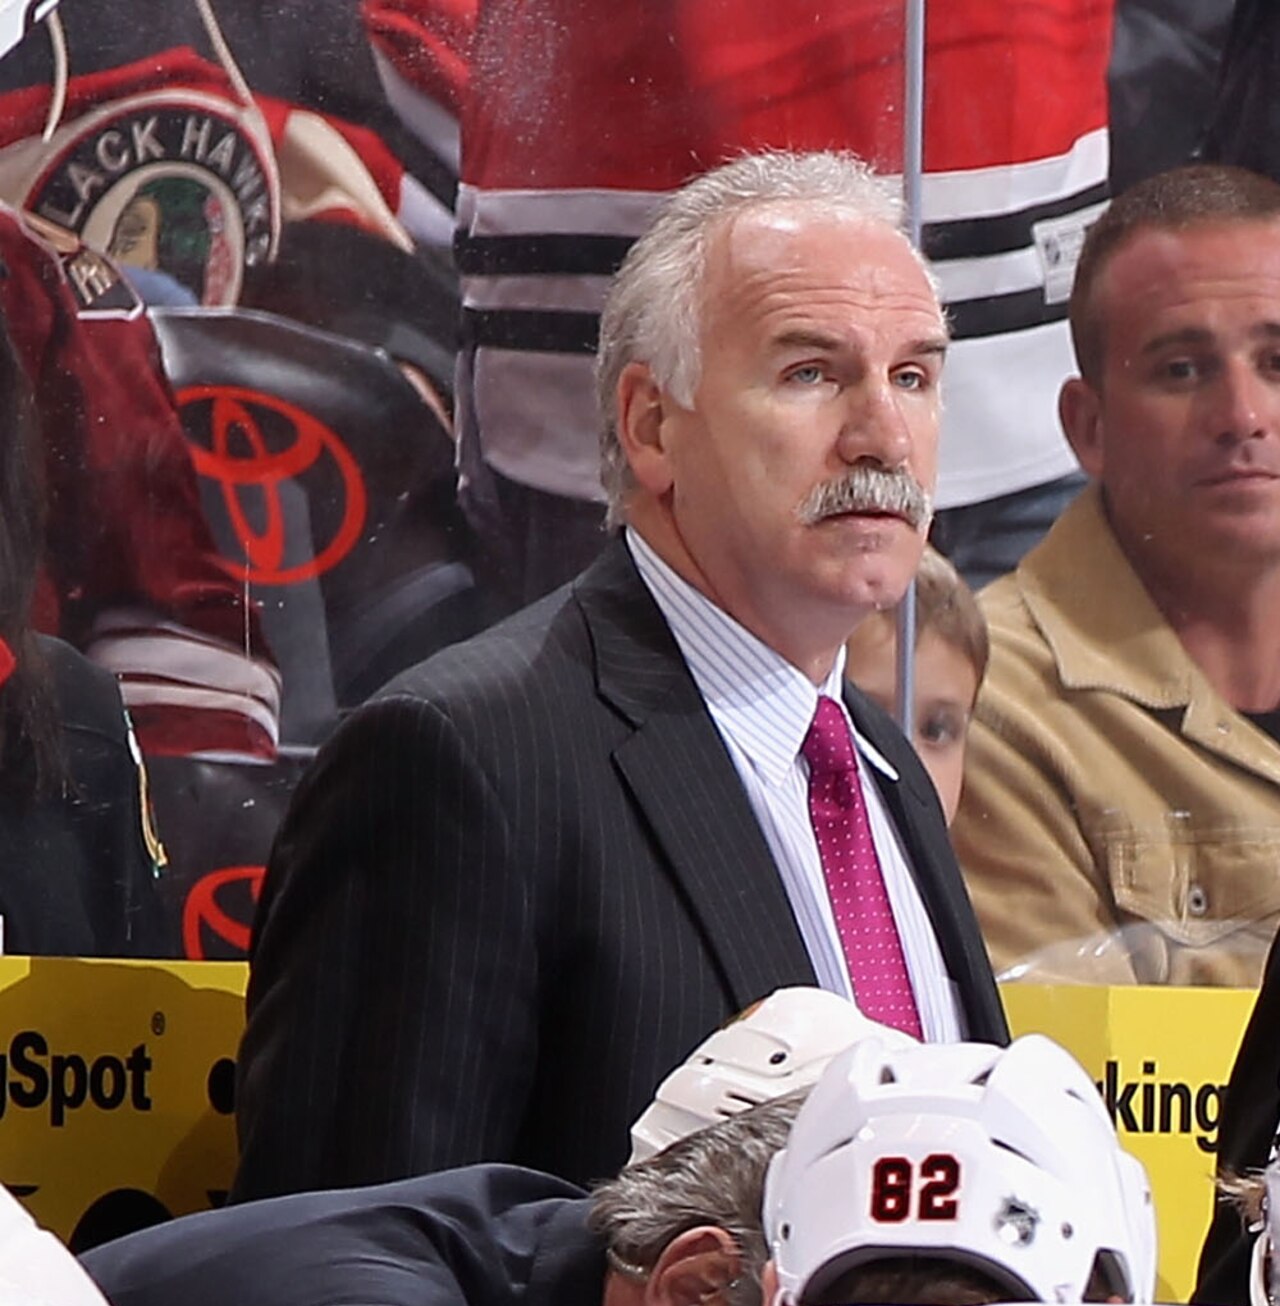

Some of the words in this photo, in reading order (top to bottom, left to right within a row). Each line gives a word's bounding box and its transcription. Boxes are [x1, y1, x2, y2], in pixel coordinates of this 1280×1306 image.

[0, 1031, 152, 1127] Spot
[1096, 1060, 1228, 1153] king
[869, 1153, 961, 1224] 82
